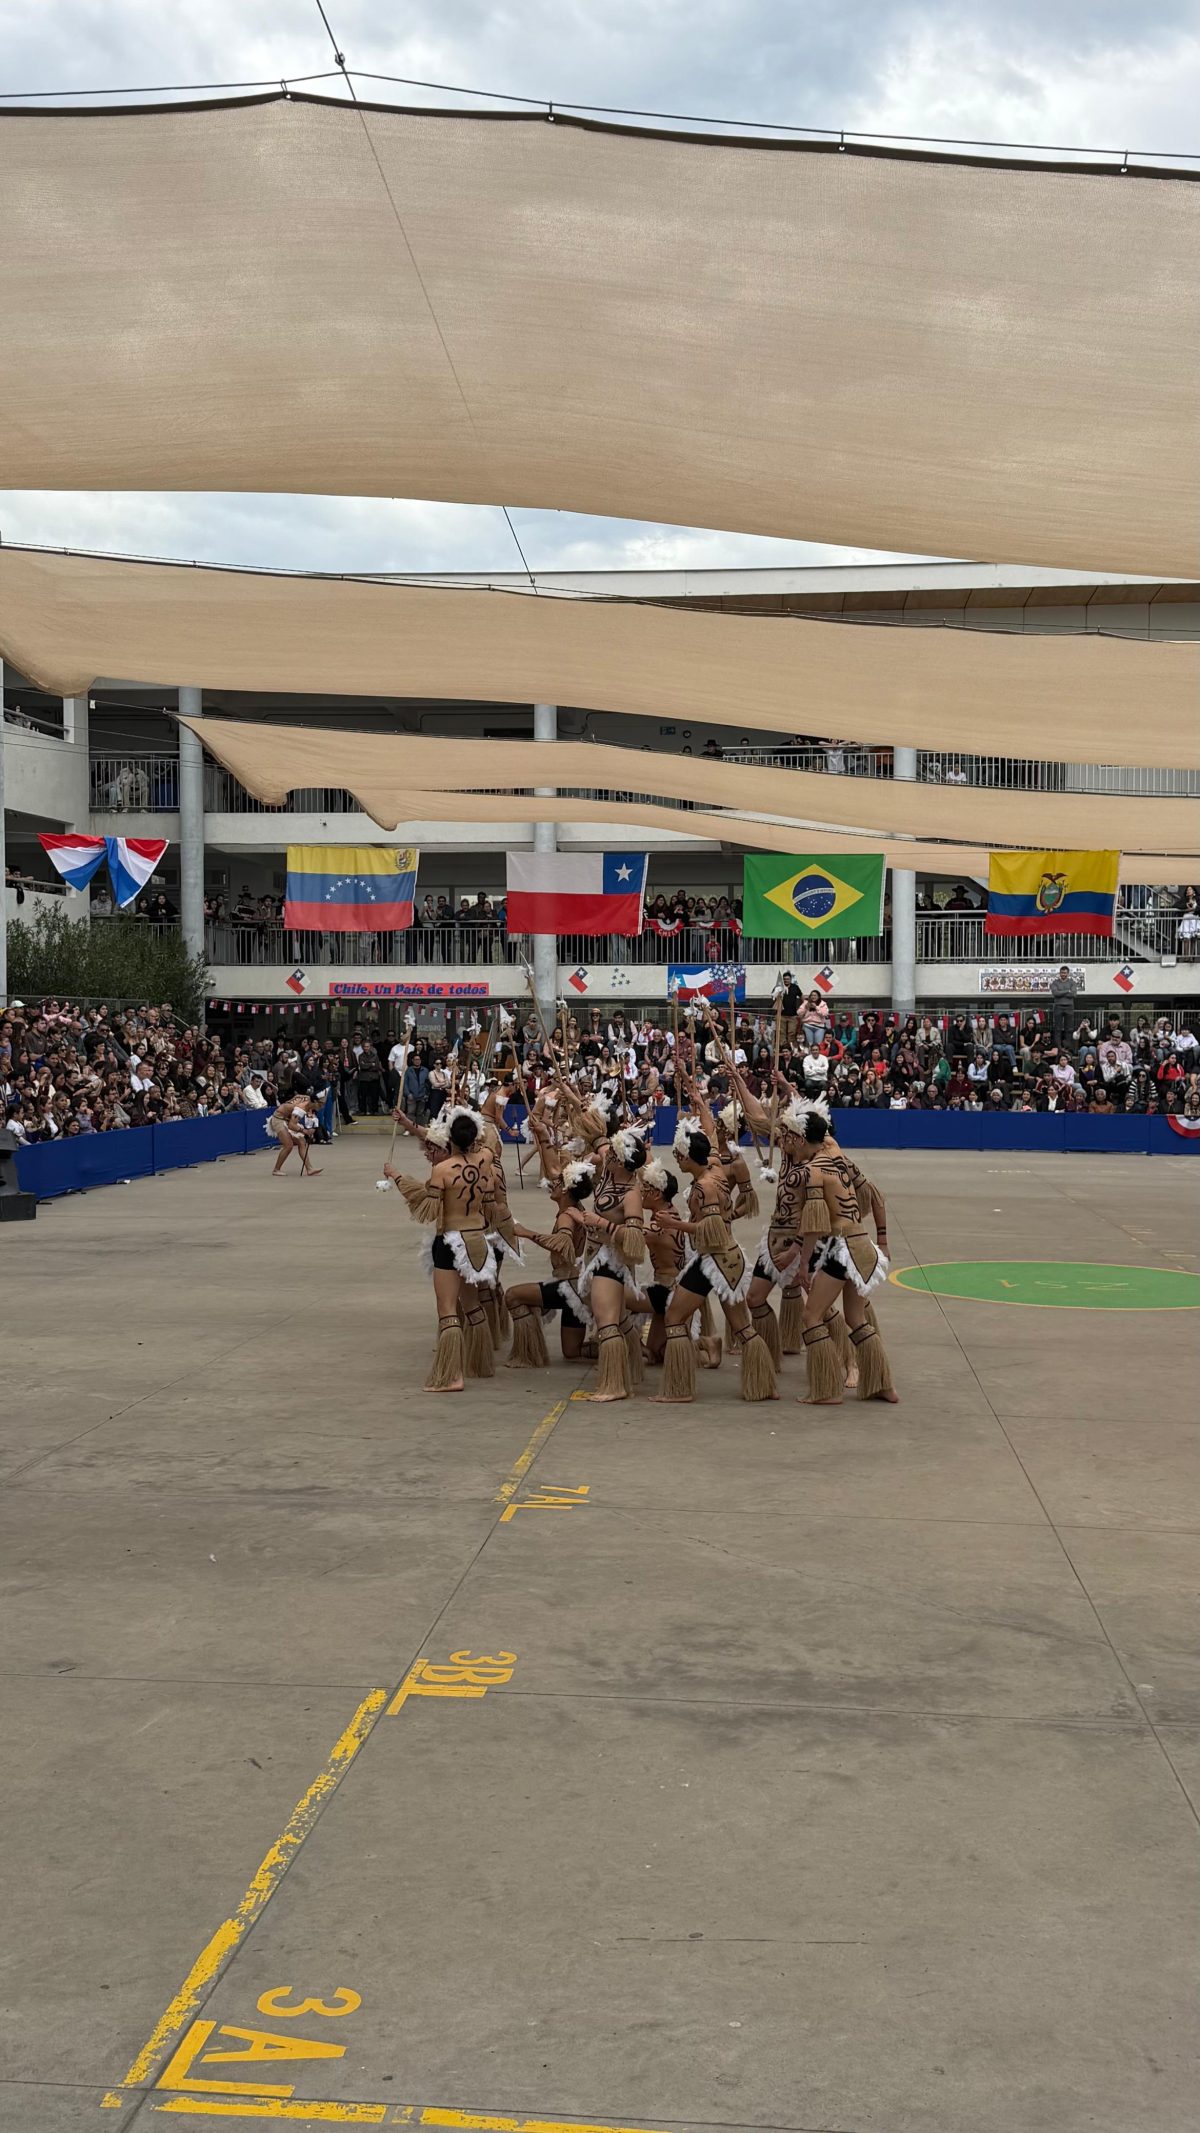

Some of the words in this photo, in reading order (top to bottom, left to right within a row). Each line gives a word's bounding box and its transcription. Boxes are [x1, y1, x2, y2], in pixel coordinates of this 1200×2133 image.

[334, 984, 371, 995] Chile,
[374, 985, 391, 994] Un
[395, 983, 423, 994] País
[427, 984, 444, 994] de
[449, 984, 487, 994] todos
